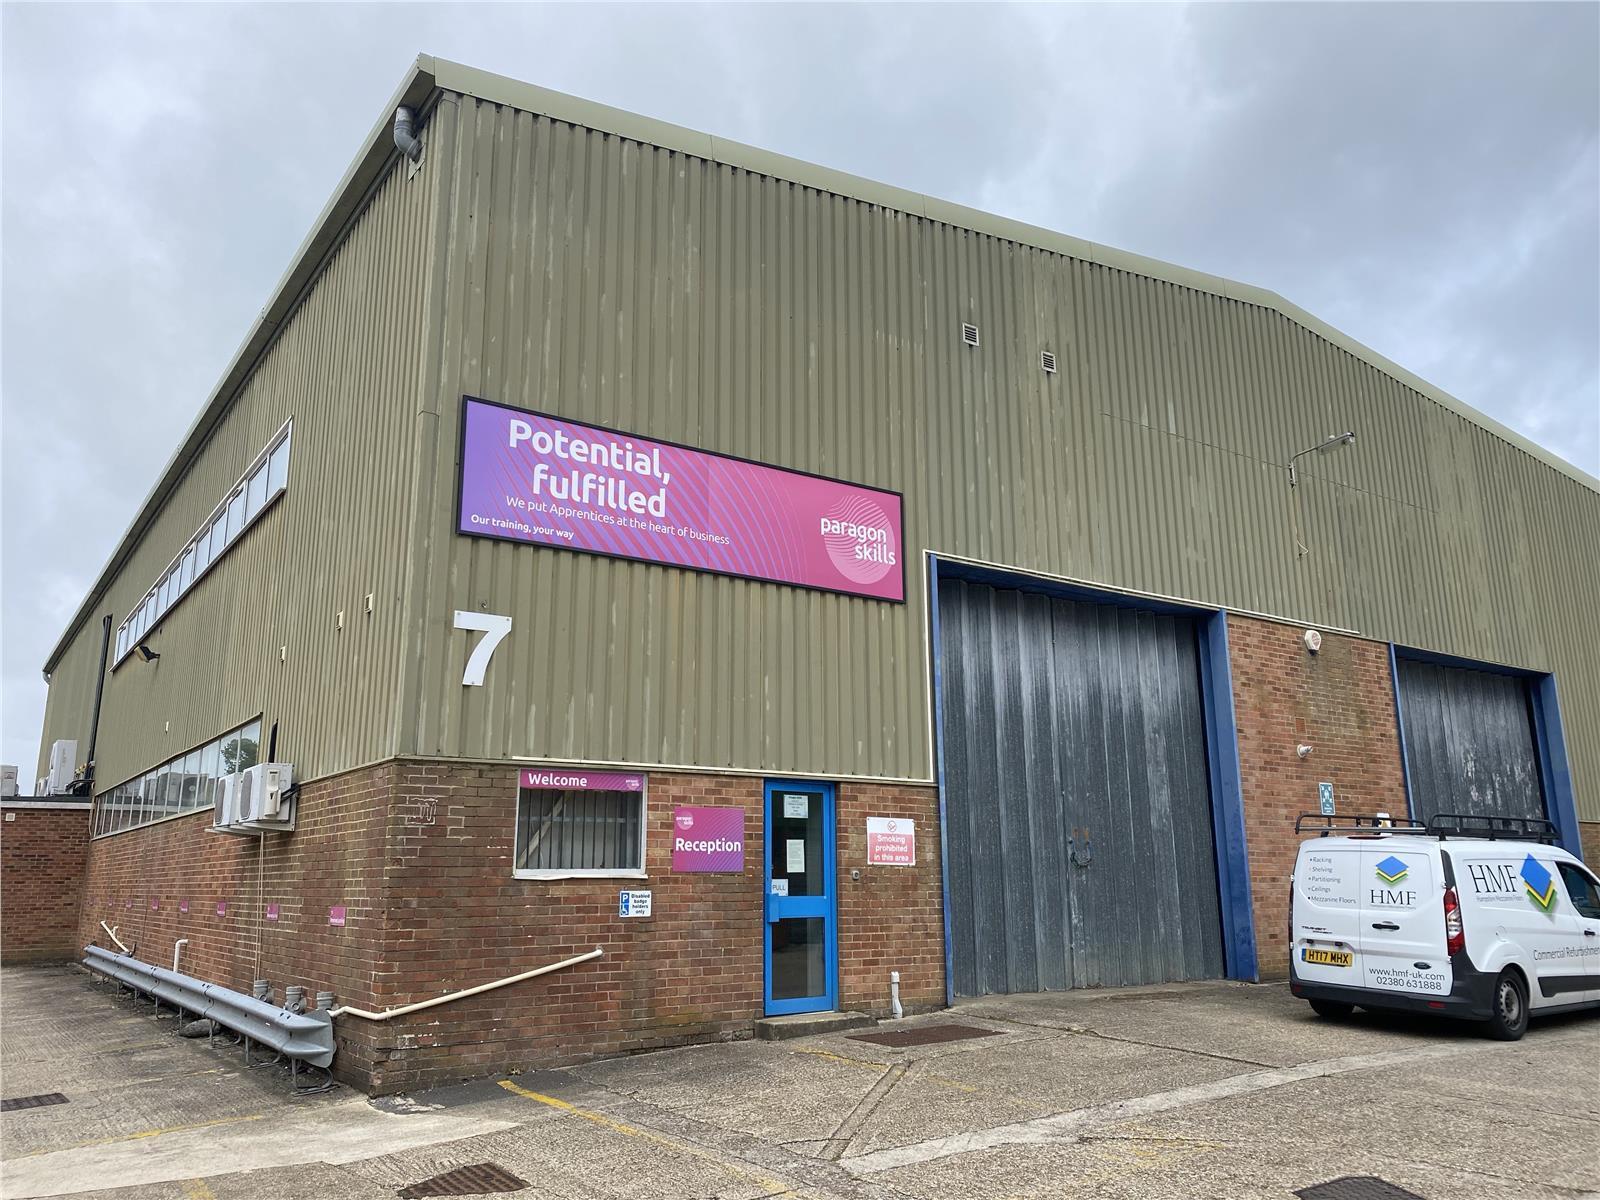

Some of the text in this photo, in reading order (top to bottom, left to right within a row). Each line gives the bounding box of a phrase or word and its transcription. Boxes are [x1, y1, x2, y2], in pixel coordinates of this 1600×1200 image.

[509, 419, 671, 485] Potential,
[532, 463, 666, 518] fulfilled
[471, 514, 574, 541] Our training, your way
[506, 496, 730, 545] We put Apprentices at the heart of business
[820, 517, 887, 543] paragon
[854, 543, 896, 566] skills
[454, 610, 512, 686] 7
[528, 773, 588, 787] Welcome
[675, 837, 741, 855] Reception
[877, 834, 906, 845] Smoking
[875, 845, 908, 853] prohibited
[873, 853, 881, 861] in
[881, 853, 894, 862] this
[1312, 866, 1333, 874] Shelving
[1311, 876, 1341, 884] Partitioning
[1467, 864, 1518, 893] HMF
[1311, 885, 1331, 893] Ceilings
[622, 893, 629, 903] P
[1339, 896, 1357, 904] Floors
[1370, 889, 1417, 906] HMF
[1308, 950, 1349, 965] HT17 MHX
[1533, 948, 1566, 960] Commercial
[1368, 967, 1446, 981] www.hmf-uk.com
[1376, 976, 1442, 991] 02380 631888
